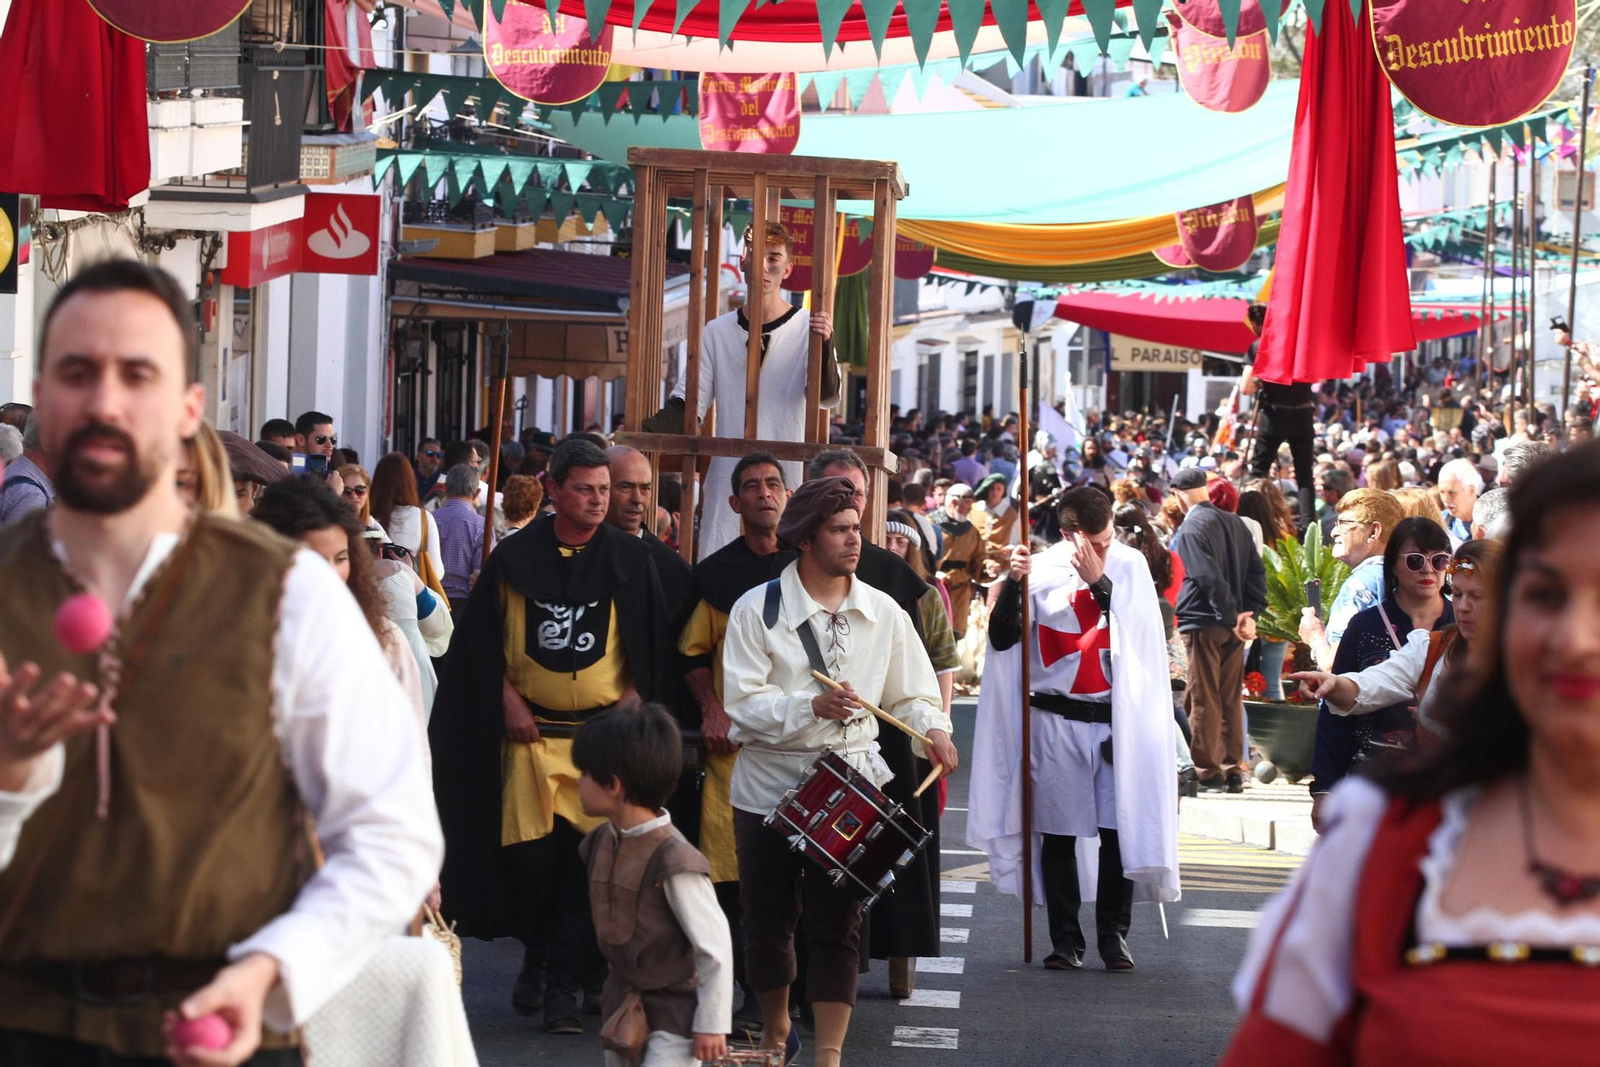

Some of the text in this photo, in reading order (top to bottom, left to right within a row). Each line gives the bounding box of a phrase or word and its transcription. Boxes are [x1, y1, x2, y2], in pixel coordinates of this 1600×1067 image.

[1384, 15, 1573, 71] Descubrimiento
[491, 42, 610, 67] Descubrimiento
[703, 76, 736, 95] Feria
[741, 98, 760, 116] del
[1130, 346, 1202, 365] PARAISO
